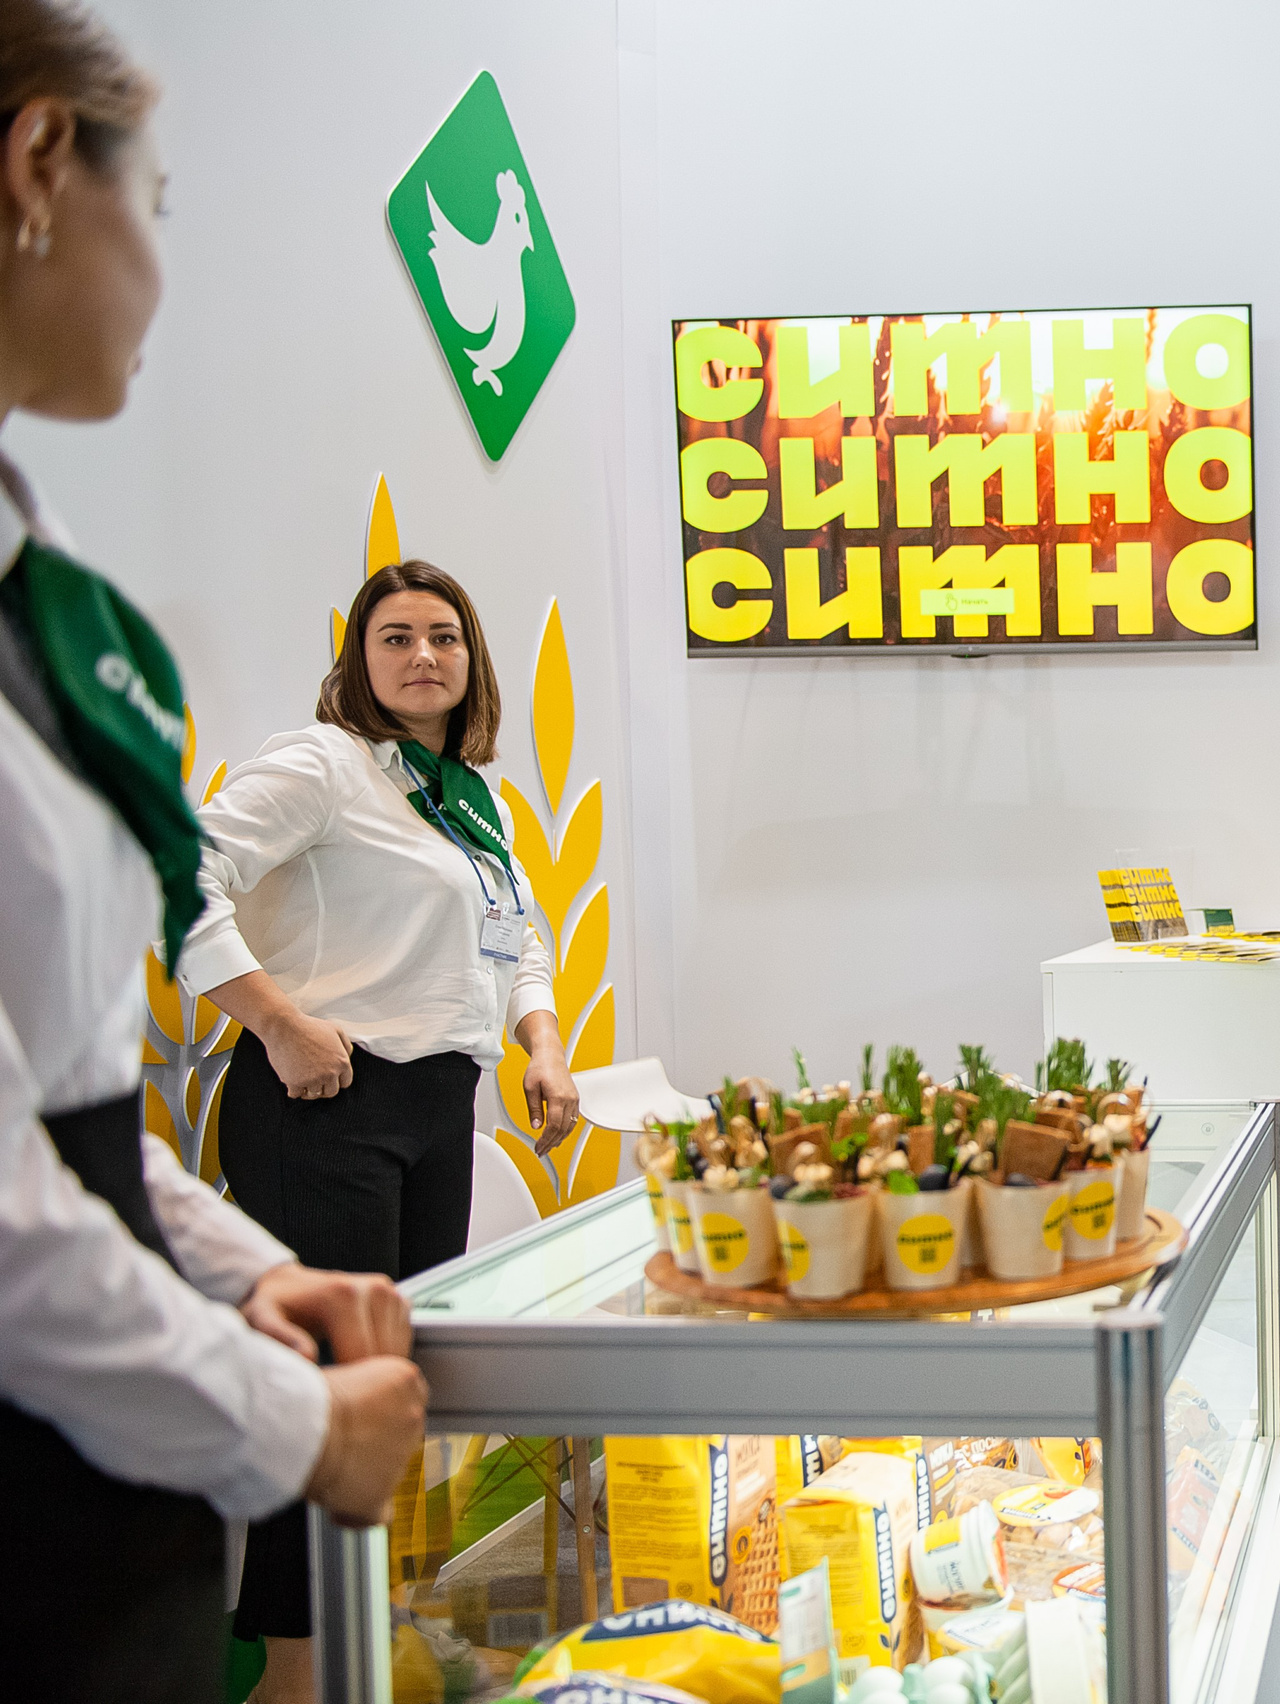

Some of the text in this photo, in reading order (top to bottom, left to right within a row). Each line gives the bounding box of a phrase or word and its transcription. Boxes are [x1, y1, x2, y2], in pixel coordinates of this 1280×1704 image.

[675, 314, 1250, 422] ситно
[680, 426, 1252, 533] ситно
[686, 538, 1254, 642] ситно
[711, 1452, 729, 1579] ситно
[876, 1512, 897, 1619] ситно
